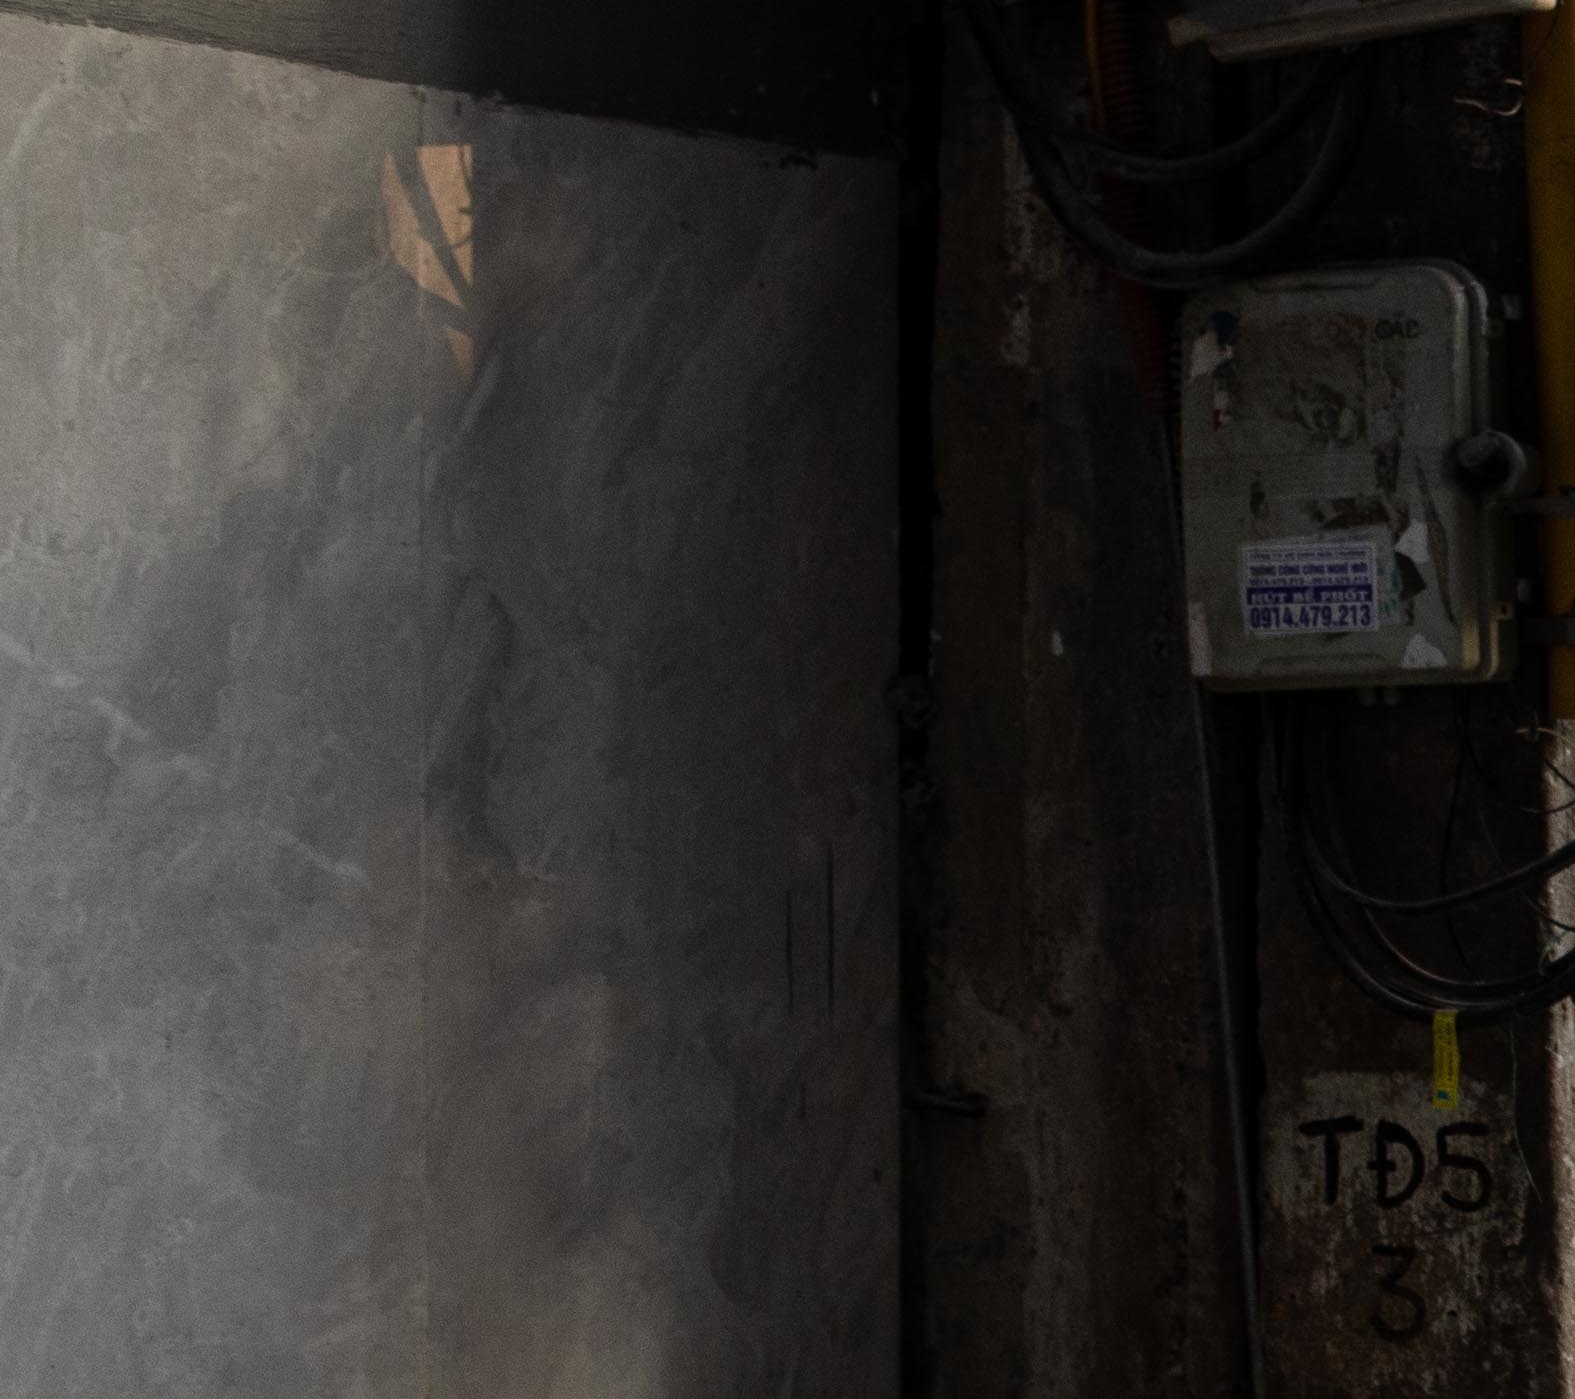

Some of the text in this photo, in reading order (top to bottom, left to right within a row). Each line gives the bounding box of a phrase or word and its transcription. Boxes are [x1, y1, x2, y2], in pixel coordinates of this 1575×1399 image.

[1250, 604, 1372, 629] 0914.479.213
[1298, 1116, 1490, 1211] TĐ5
[1371, 1245, 1425, 1342] 3
